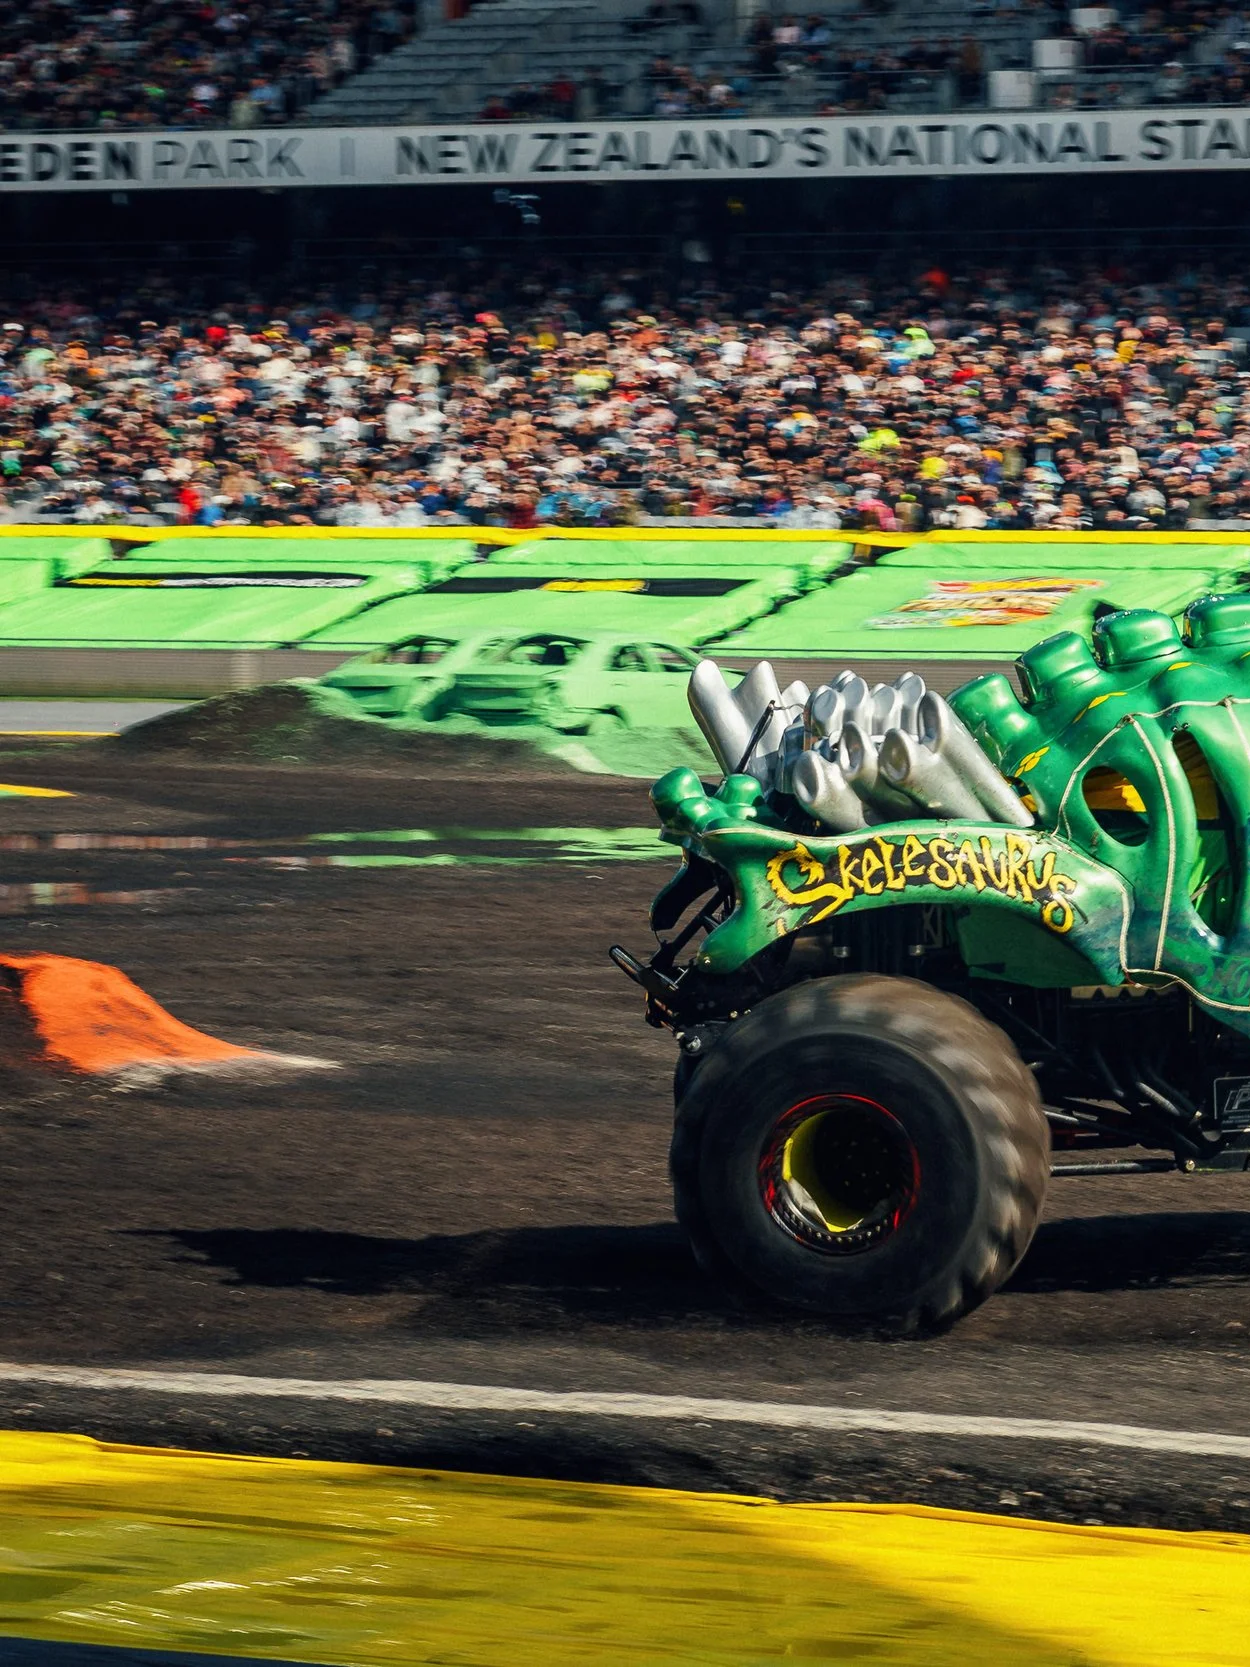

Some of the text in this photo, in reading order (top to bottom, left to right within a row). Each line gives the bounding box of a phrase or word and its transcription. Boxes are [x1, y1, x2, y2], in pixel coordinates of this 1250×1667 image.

[0, 137, 305, 182] EDEN PARK
[395, 133, 519, 175] NEW
[528, 127, 831, 173] ZEALAND'S
[843, 121, 1128, 168] NATIONAL
